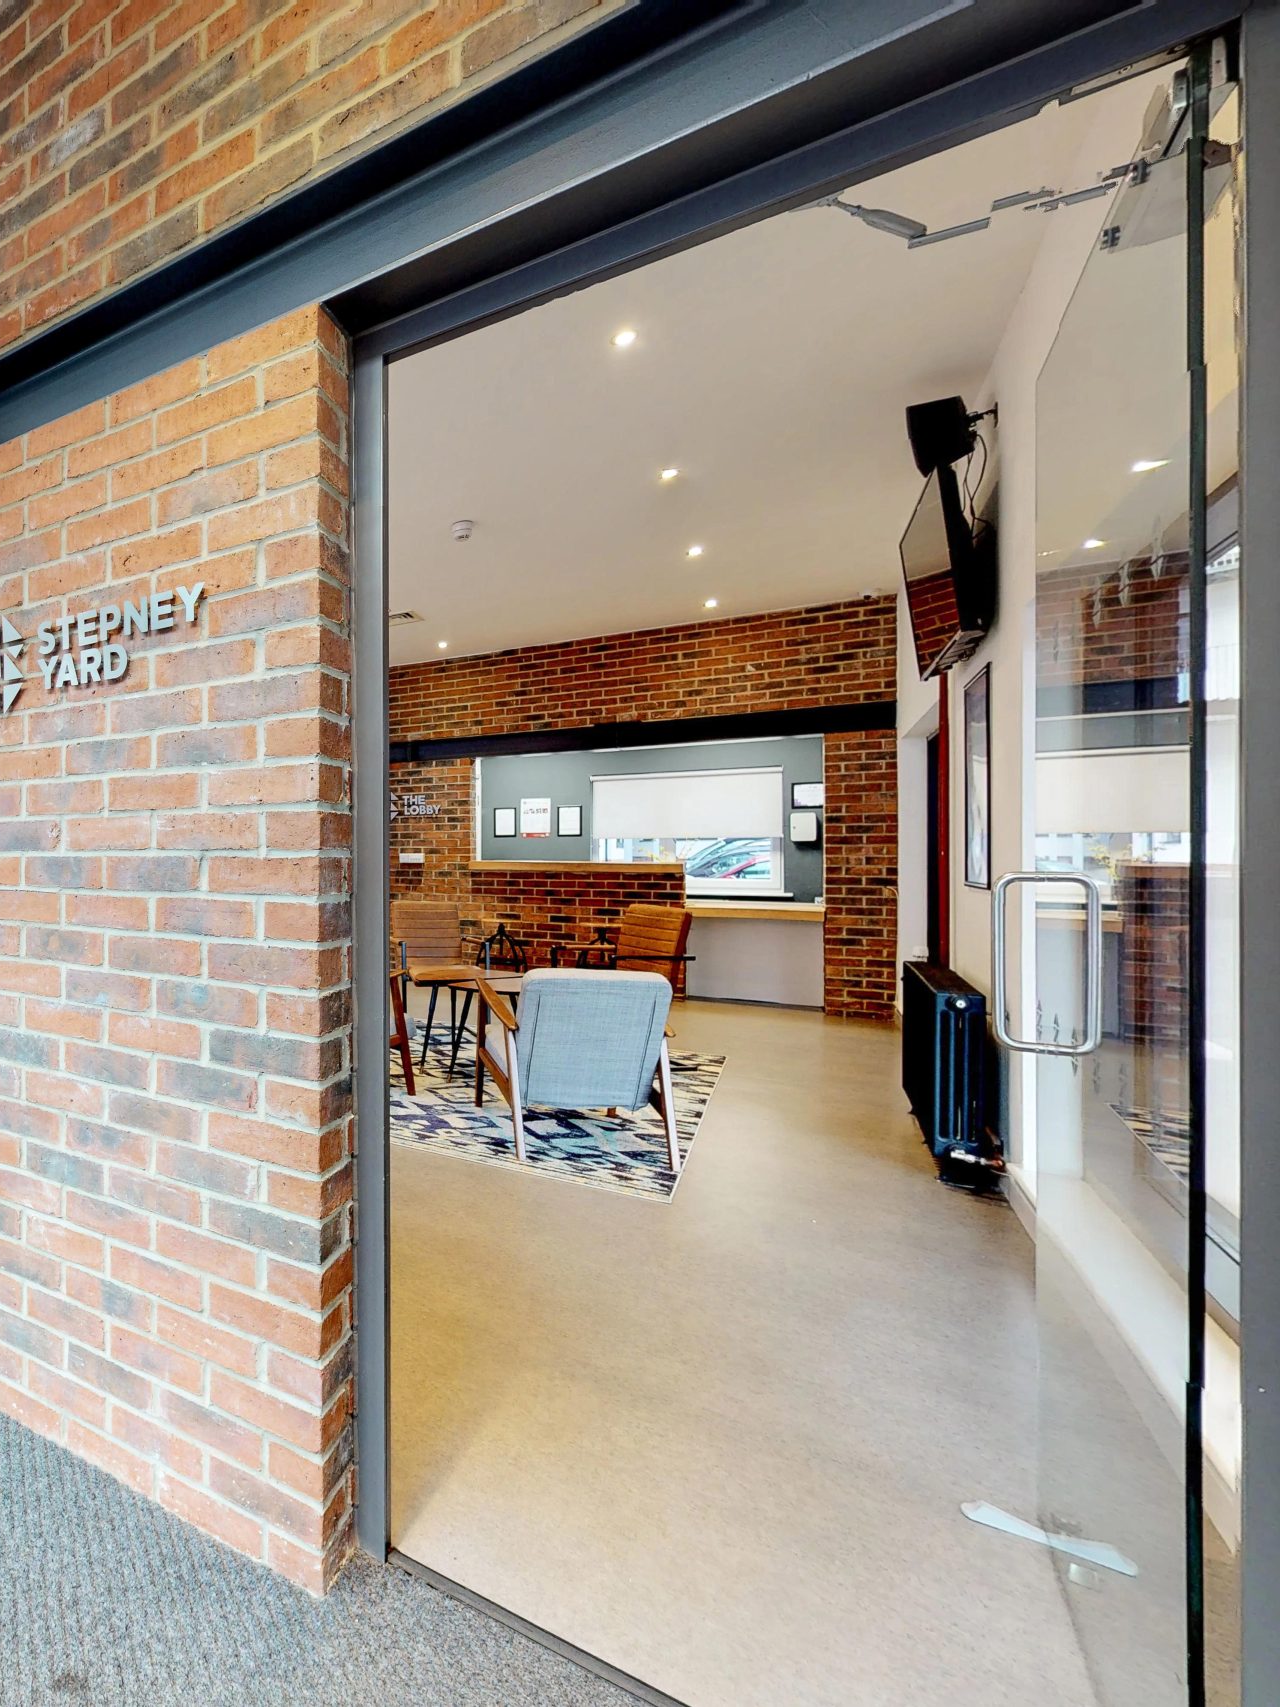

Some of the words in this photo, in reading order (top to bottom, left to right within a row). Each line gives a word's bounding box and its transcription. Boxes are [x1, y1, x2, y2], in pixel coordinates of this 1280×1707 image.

[37, 582, 205, 655] STEPNEY
[37, 643, 128, 690] YARD
[402, 795, 426, 806] THE
[404, 805, 441, 816] LOBBY
